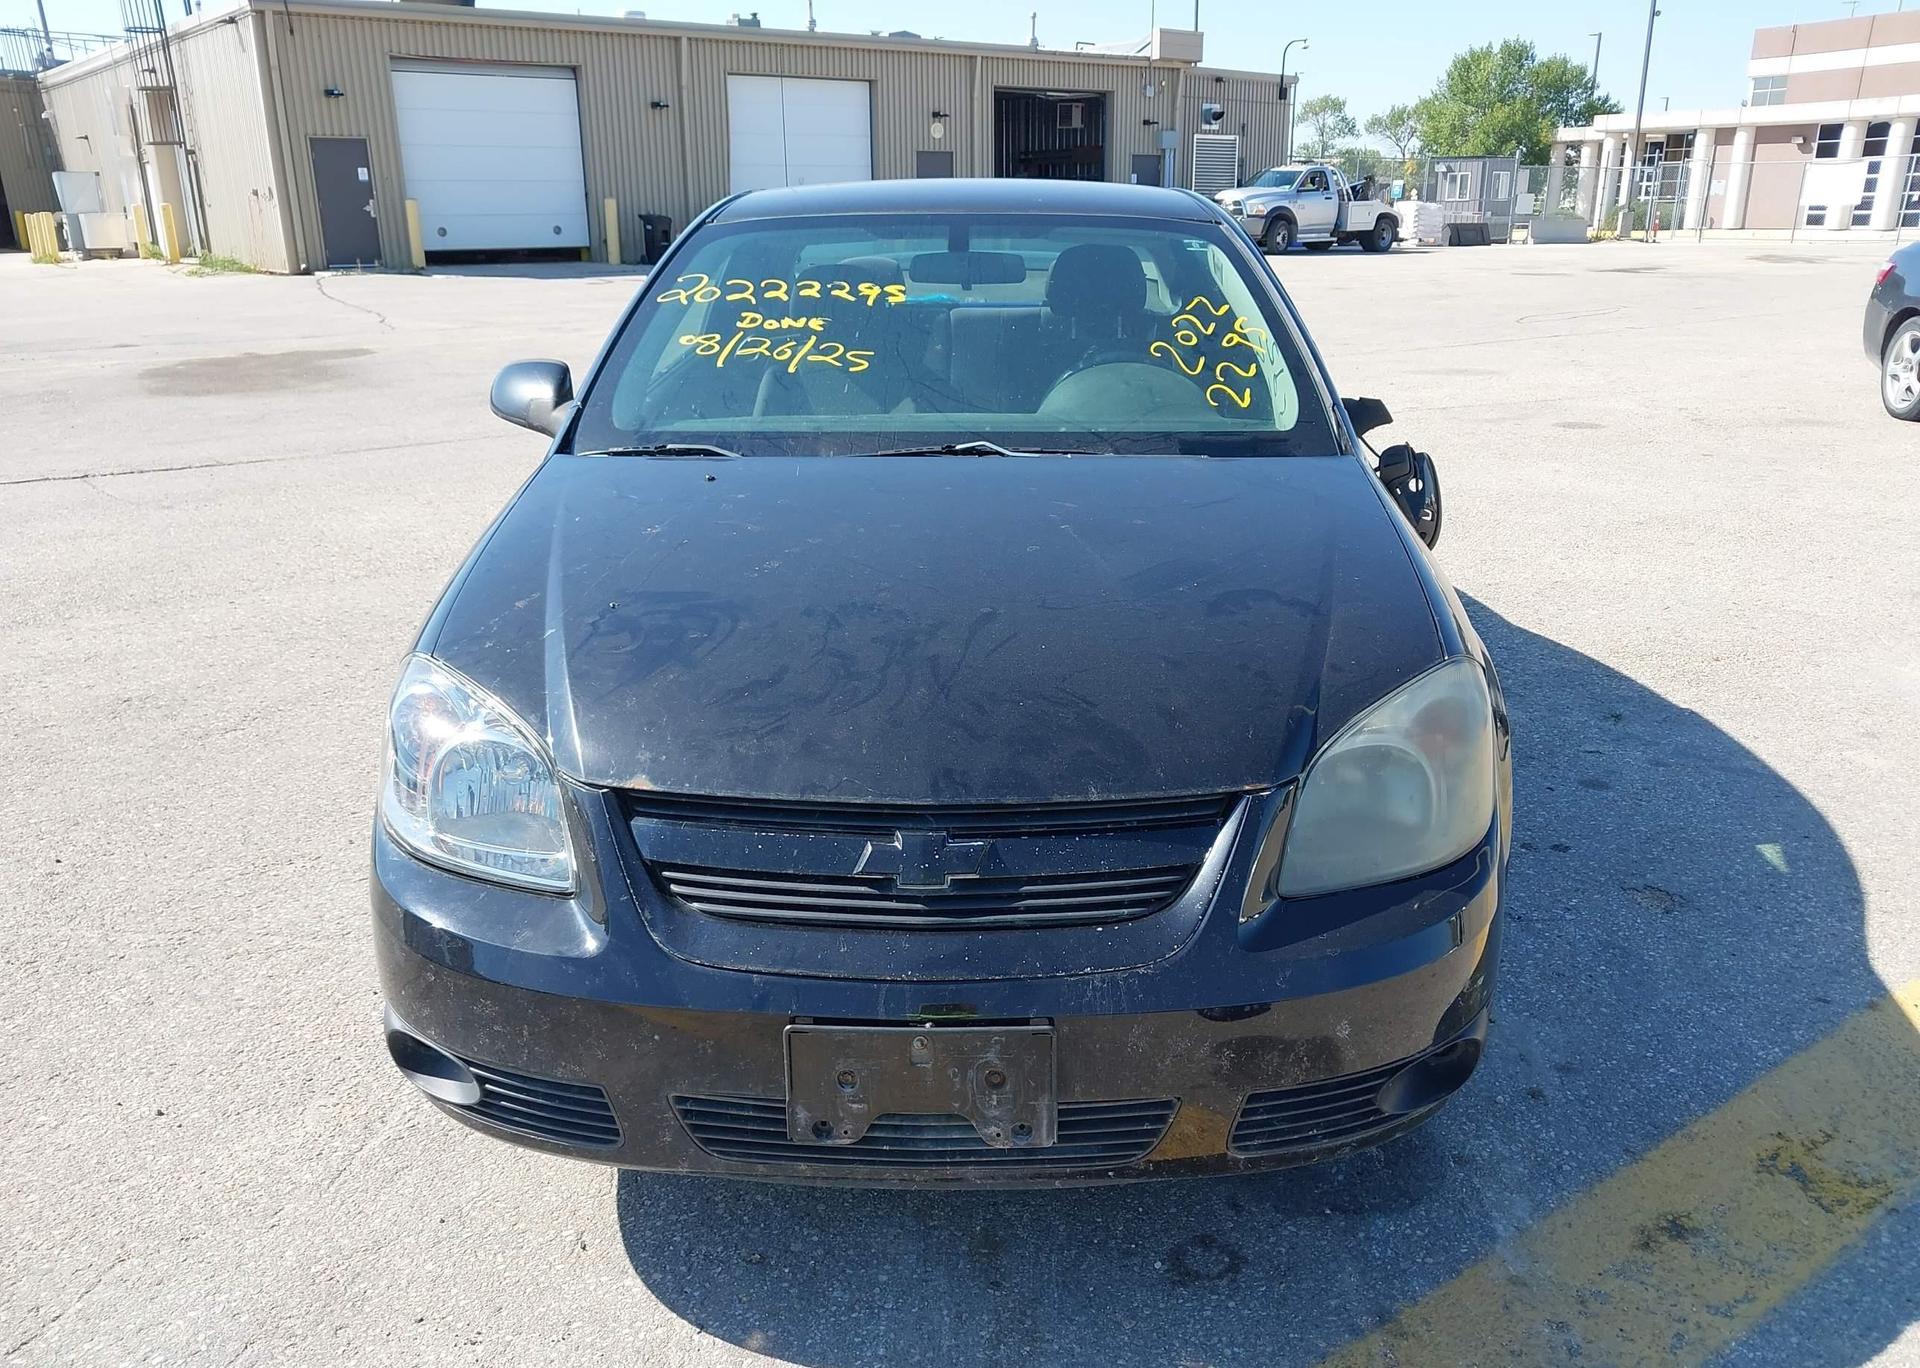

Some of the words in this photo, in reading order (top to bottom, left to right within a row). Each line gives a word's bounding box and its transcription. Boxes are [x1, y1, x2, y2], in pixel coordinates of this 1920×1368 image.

[657, 274, 906, 306] 20222295
[679, 331, 875, 373] 08/26/25
[1150, 296, 1230, 375] 2022
